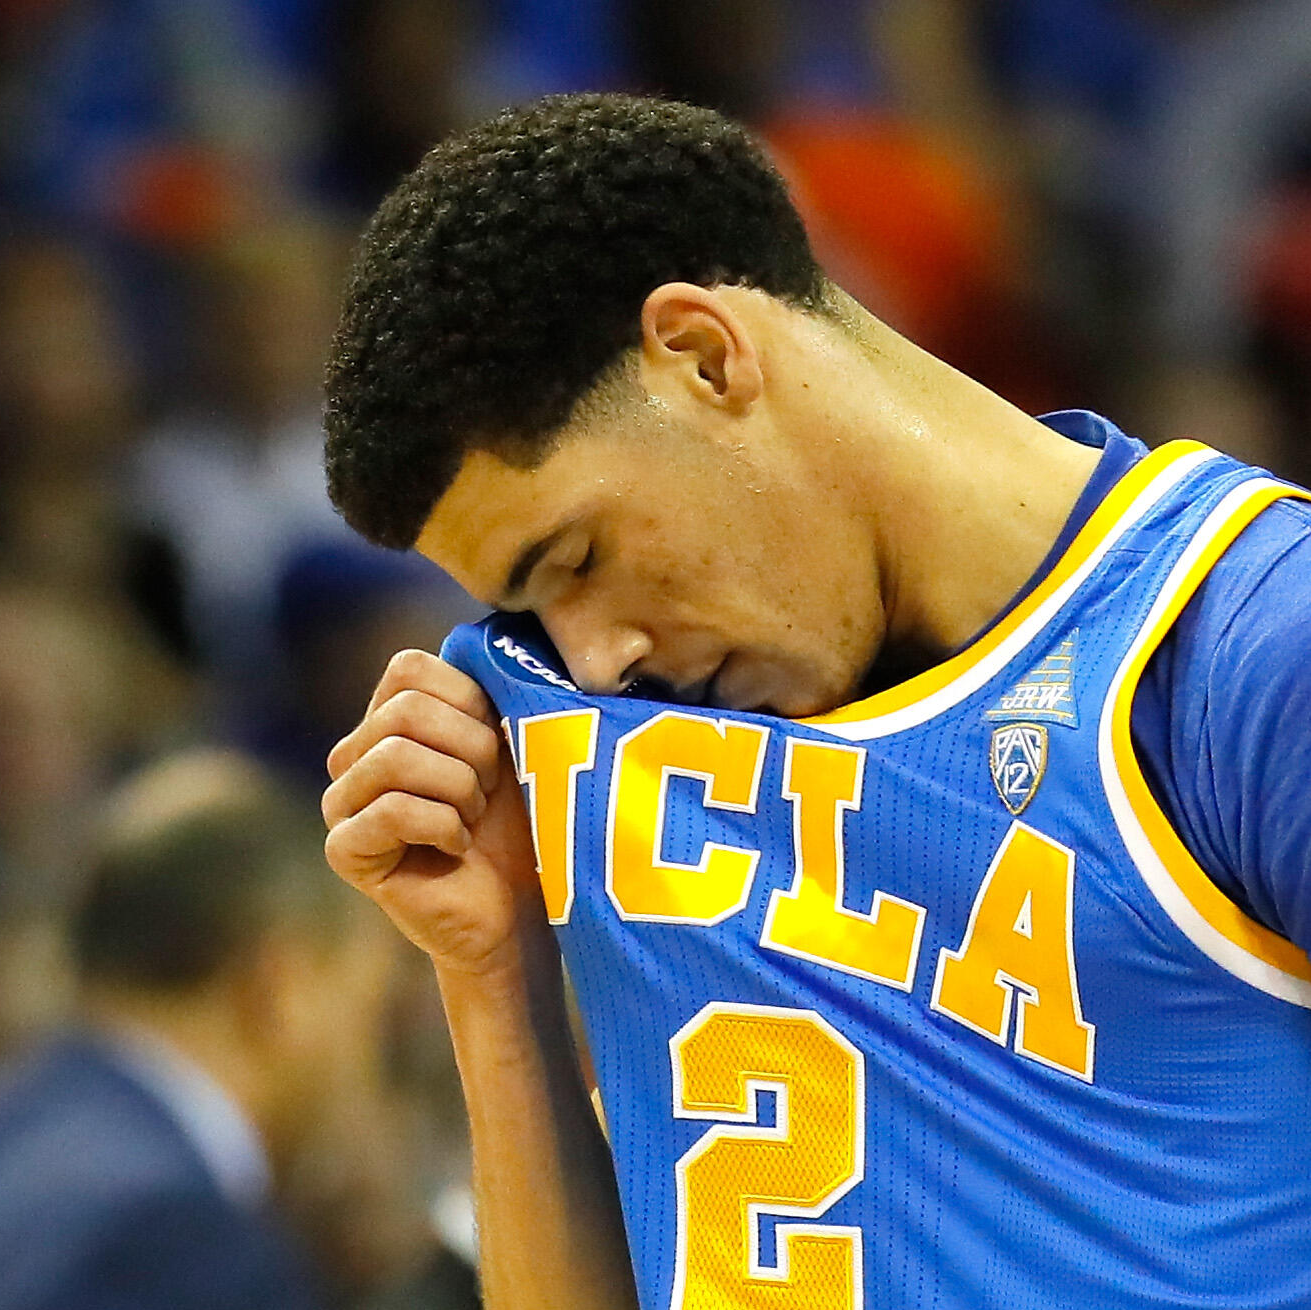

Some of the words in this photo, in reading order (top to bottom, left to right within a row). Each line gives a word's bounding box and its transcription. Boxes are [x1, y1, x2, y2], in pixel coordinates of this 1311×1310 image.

[493, 635, 578, 692] NCAA
[1002, 686, 1068, 709] JRW
[1004, 762, 1030, 796] 12
